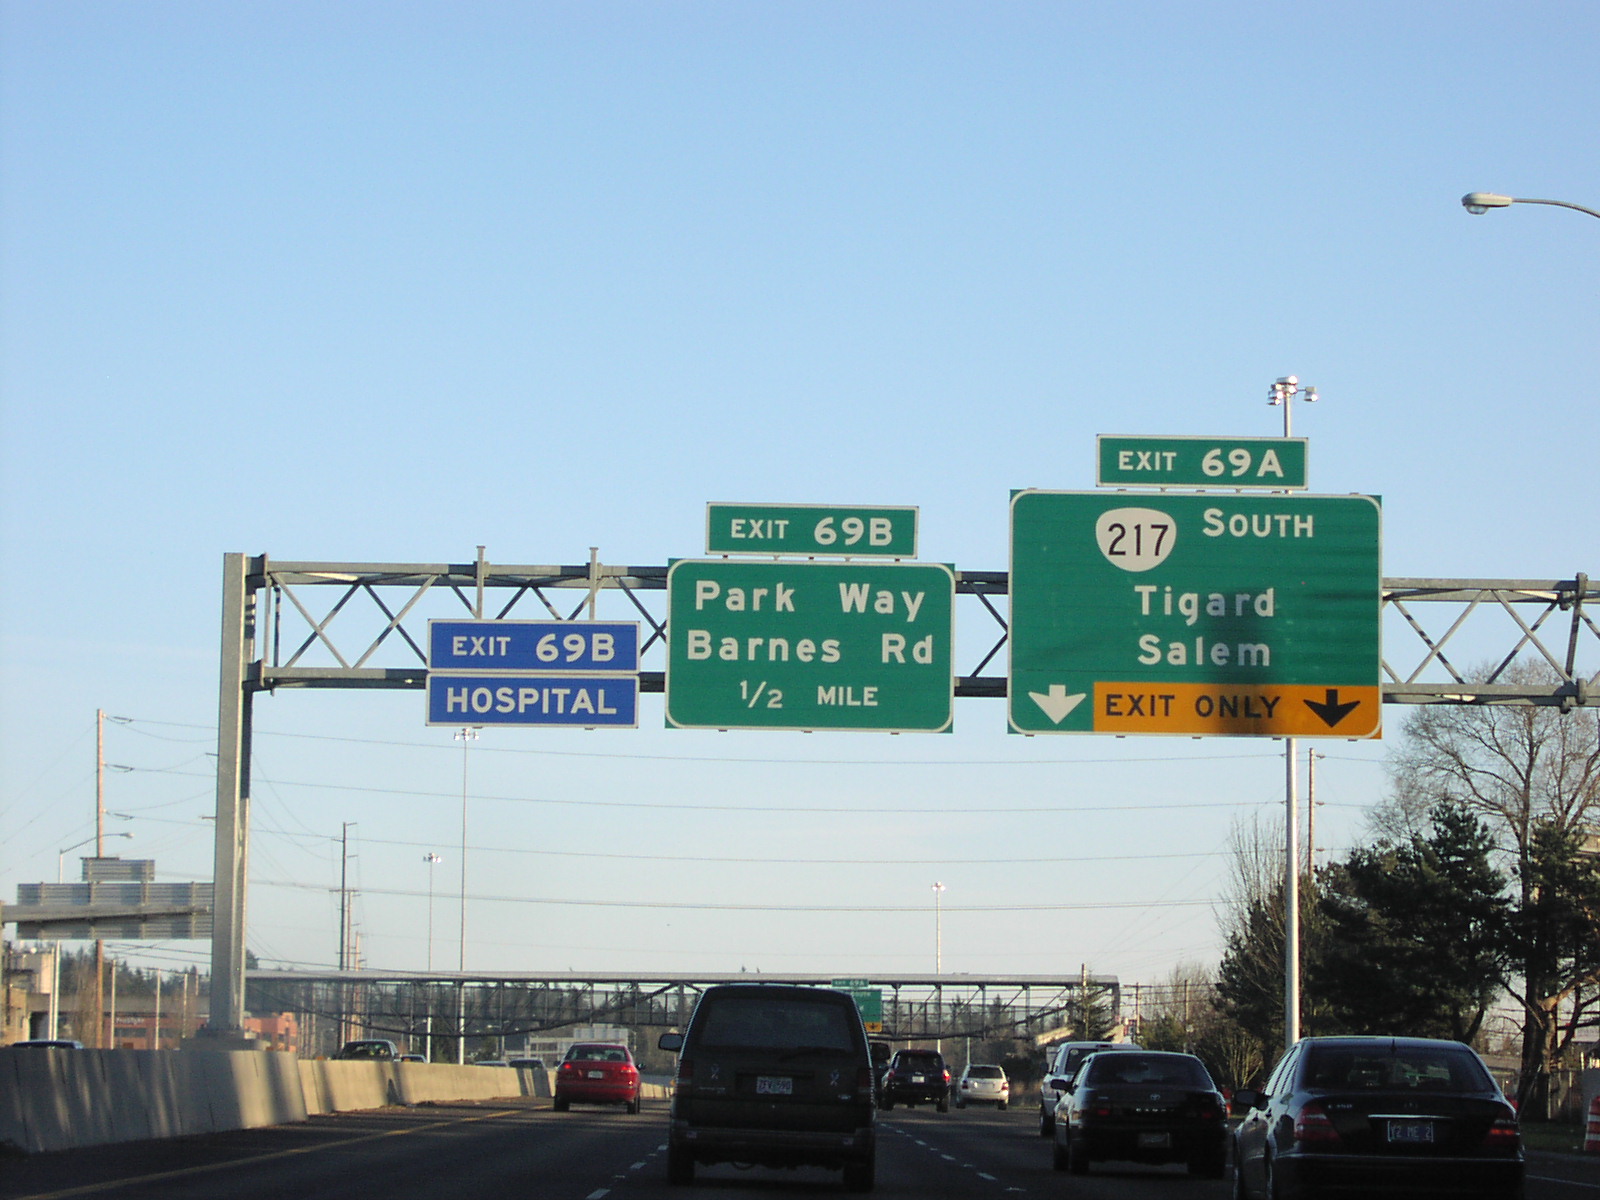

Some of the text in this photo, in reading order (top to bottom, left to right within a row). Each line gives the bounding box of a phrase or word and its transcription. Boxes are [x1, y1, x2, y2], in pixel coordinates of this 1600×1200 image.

[1119, 448, 1283, 477] EXIT 69A
[730, 517, 893, 546] EXIT 69B
[1203, 508, 1314, 538] SOUTH
[1109, 524, 1169, 556] 217
[695, 580, 926, 622] Park Way
[1134, 585, 1276, 626] Tigard
[452, 633, 615, 663] EXIT 69B
[687, 629, 933, 665] Barnes Rd
[1138, 633, 1270, 666] Salem
[446, 686, 617, 714] HOSPITAL
[817, 685, 879, 707] MILE
[1106, 694, 1280, 719] EXIT ONLY
